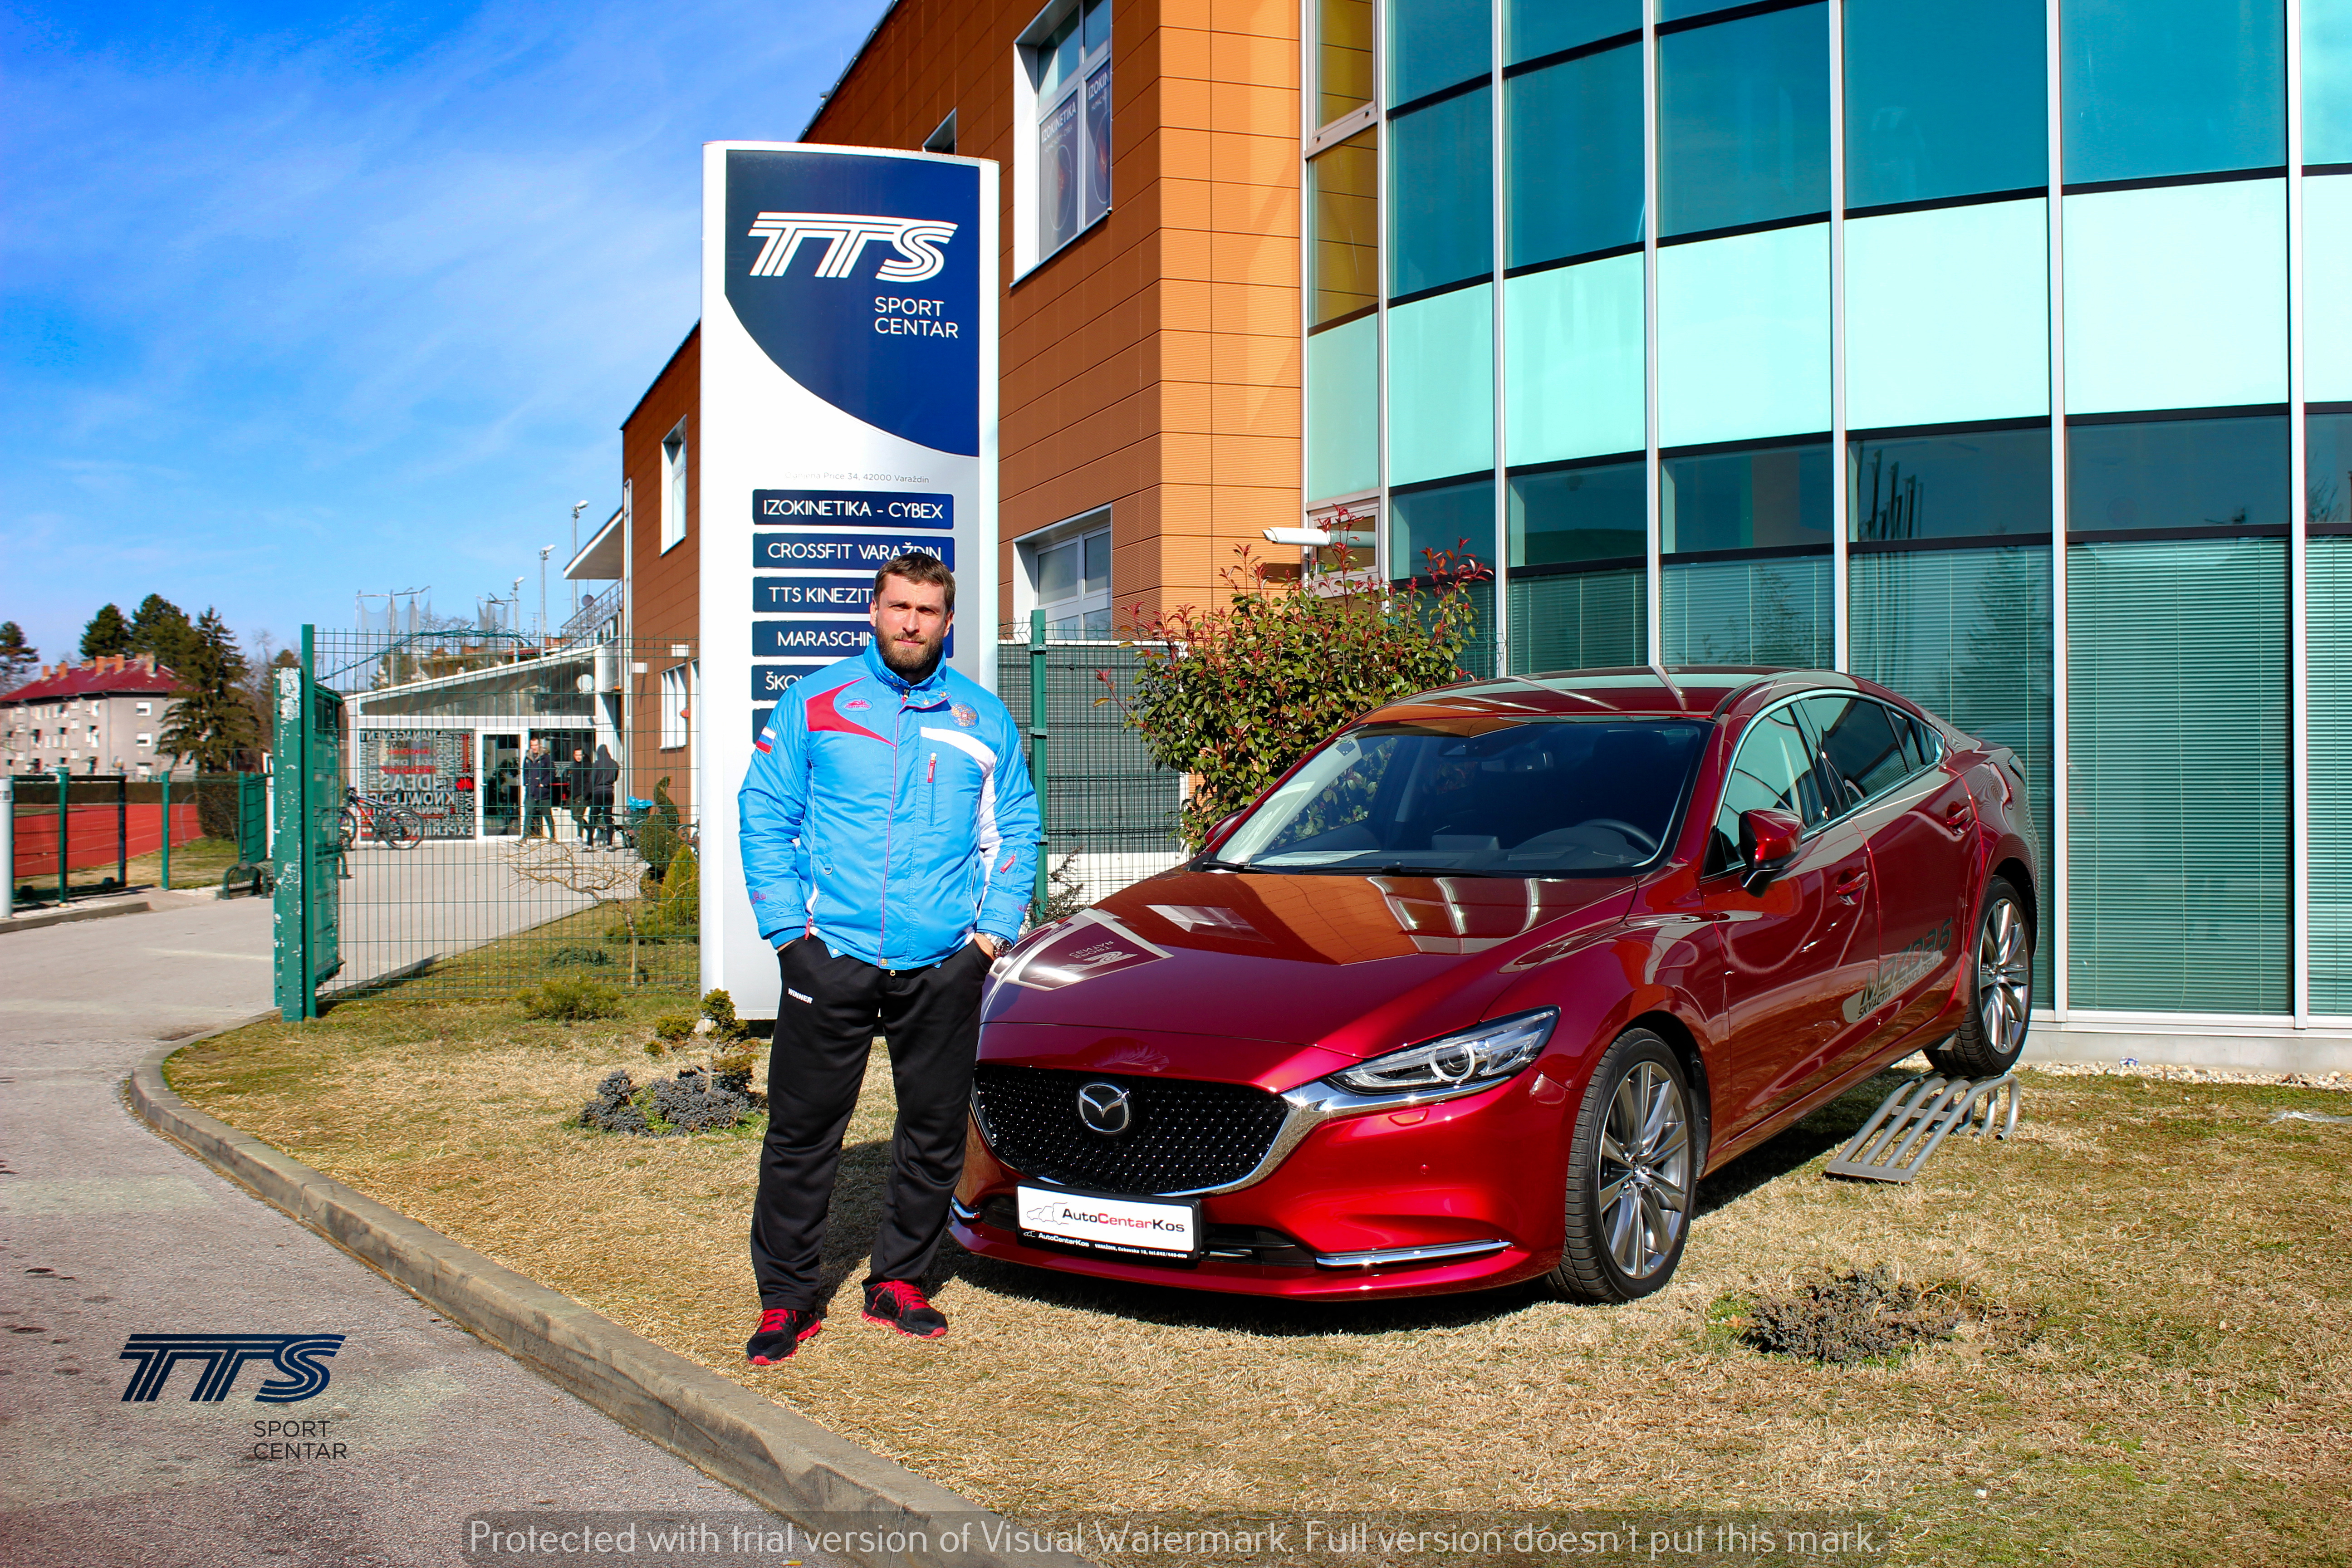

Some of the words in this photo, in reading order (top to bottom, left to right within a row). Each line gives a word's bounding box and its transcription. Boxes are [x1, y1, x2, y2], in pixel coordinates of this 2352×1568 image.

[1042, 101, 1077, 143] IZOKINETIKA
[748, 211, 959, 283] TTS
[874, 296, 945, 317] SPORT
[874, 318, 959, 339] CENTAR
[785, 471, 821, 480] Ognjena
[847, 473, 861, 481] 34,
[894, 475, 930, 484] Varaždin
[763, 500, 872, 517] IZOKINETIKA
[888, 502, 944, 519] CYBEX
[767, 542, 853, 559] CROSSFIT
[768, 587, 802, 603] TTS
[806, 587, 874, 603] KINEZIT
[777, 631, 873, 647] MARASCHIN
[765, 671, 803, 691] ŠKO
[788, 987, 813, 1004] WINNER
[1857, 986, 1893, 1019] SKYACTIV
[1062, 1208, 1185, 1233] AutoCentarKos
[1038, 1232, 1090, 1248] AutoCentarKos
